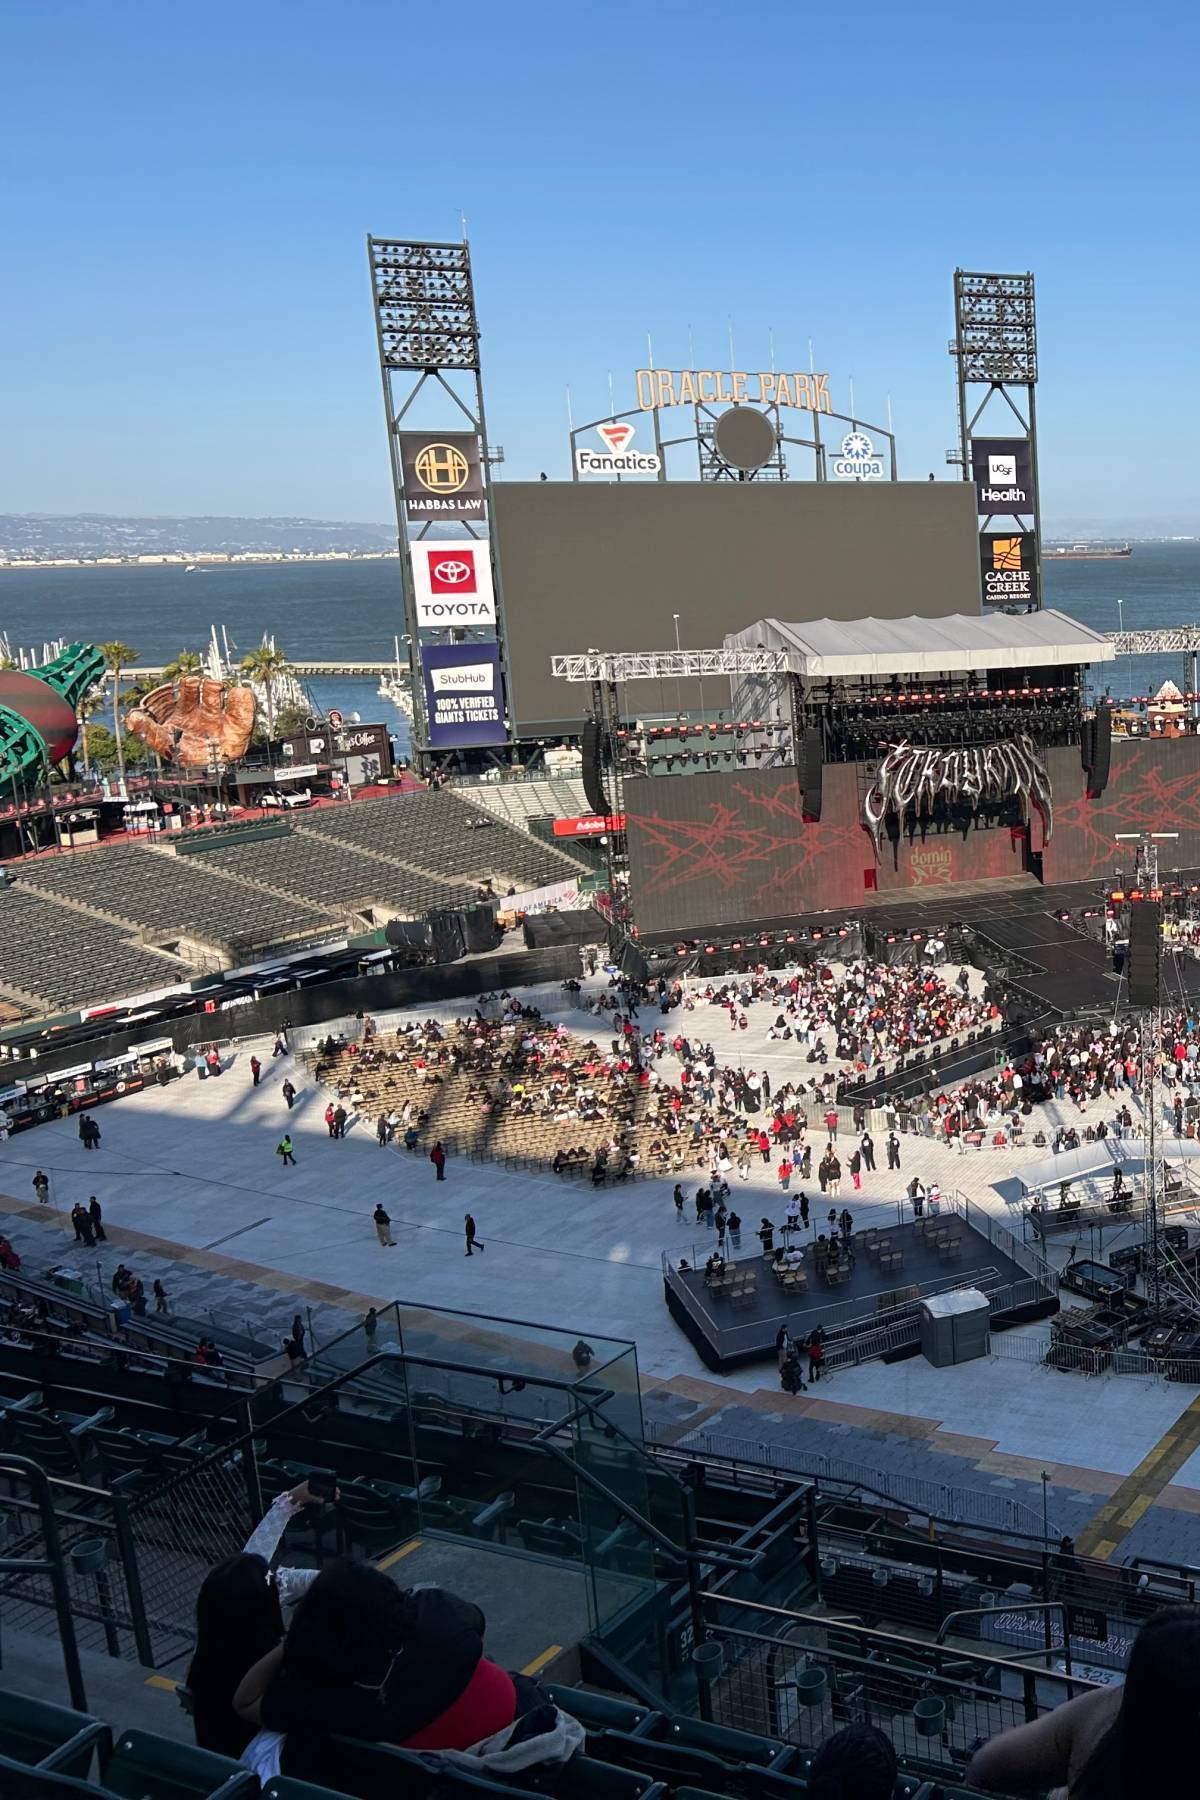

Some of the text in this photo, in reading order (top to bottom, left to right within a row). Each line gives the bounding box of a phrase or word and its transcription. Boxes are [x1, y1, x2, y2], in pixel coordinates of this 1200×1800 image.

[636, 369, 833, 414] ORACLE PARK
[580, 453, 657, 470] Fanatics
[836, 460, 880, 477] coupa
[992, 464, 1013, 475] UCSF
[981, 488, 1026, 501] Health
[408, 499, 481, 510] HABBAS LAW
[985, 571, 1030, 582] CACHE
[986, 582, 1030, 593] CREEK
[421, 603, 491, 617] TOYOTA
[440, 674, 486, 685] StubHub
[436, 696, 495, 711] 100% VERIFIED
[435, 708, 499, 724] GIANTS TICKETS
[354, 732, 375, 746] Coffee
[911, 847, 951, 865] domin
[1079, 1666, 1114, 1684] 323
